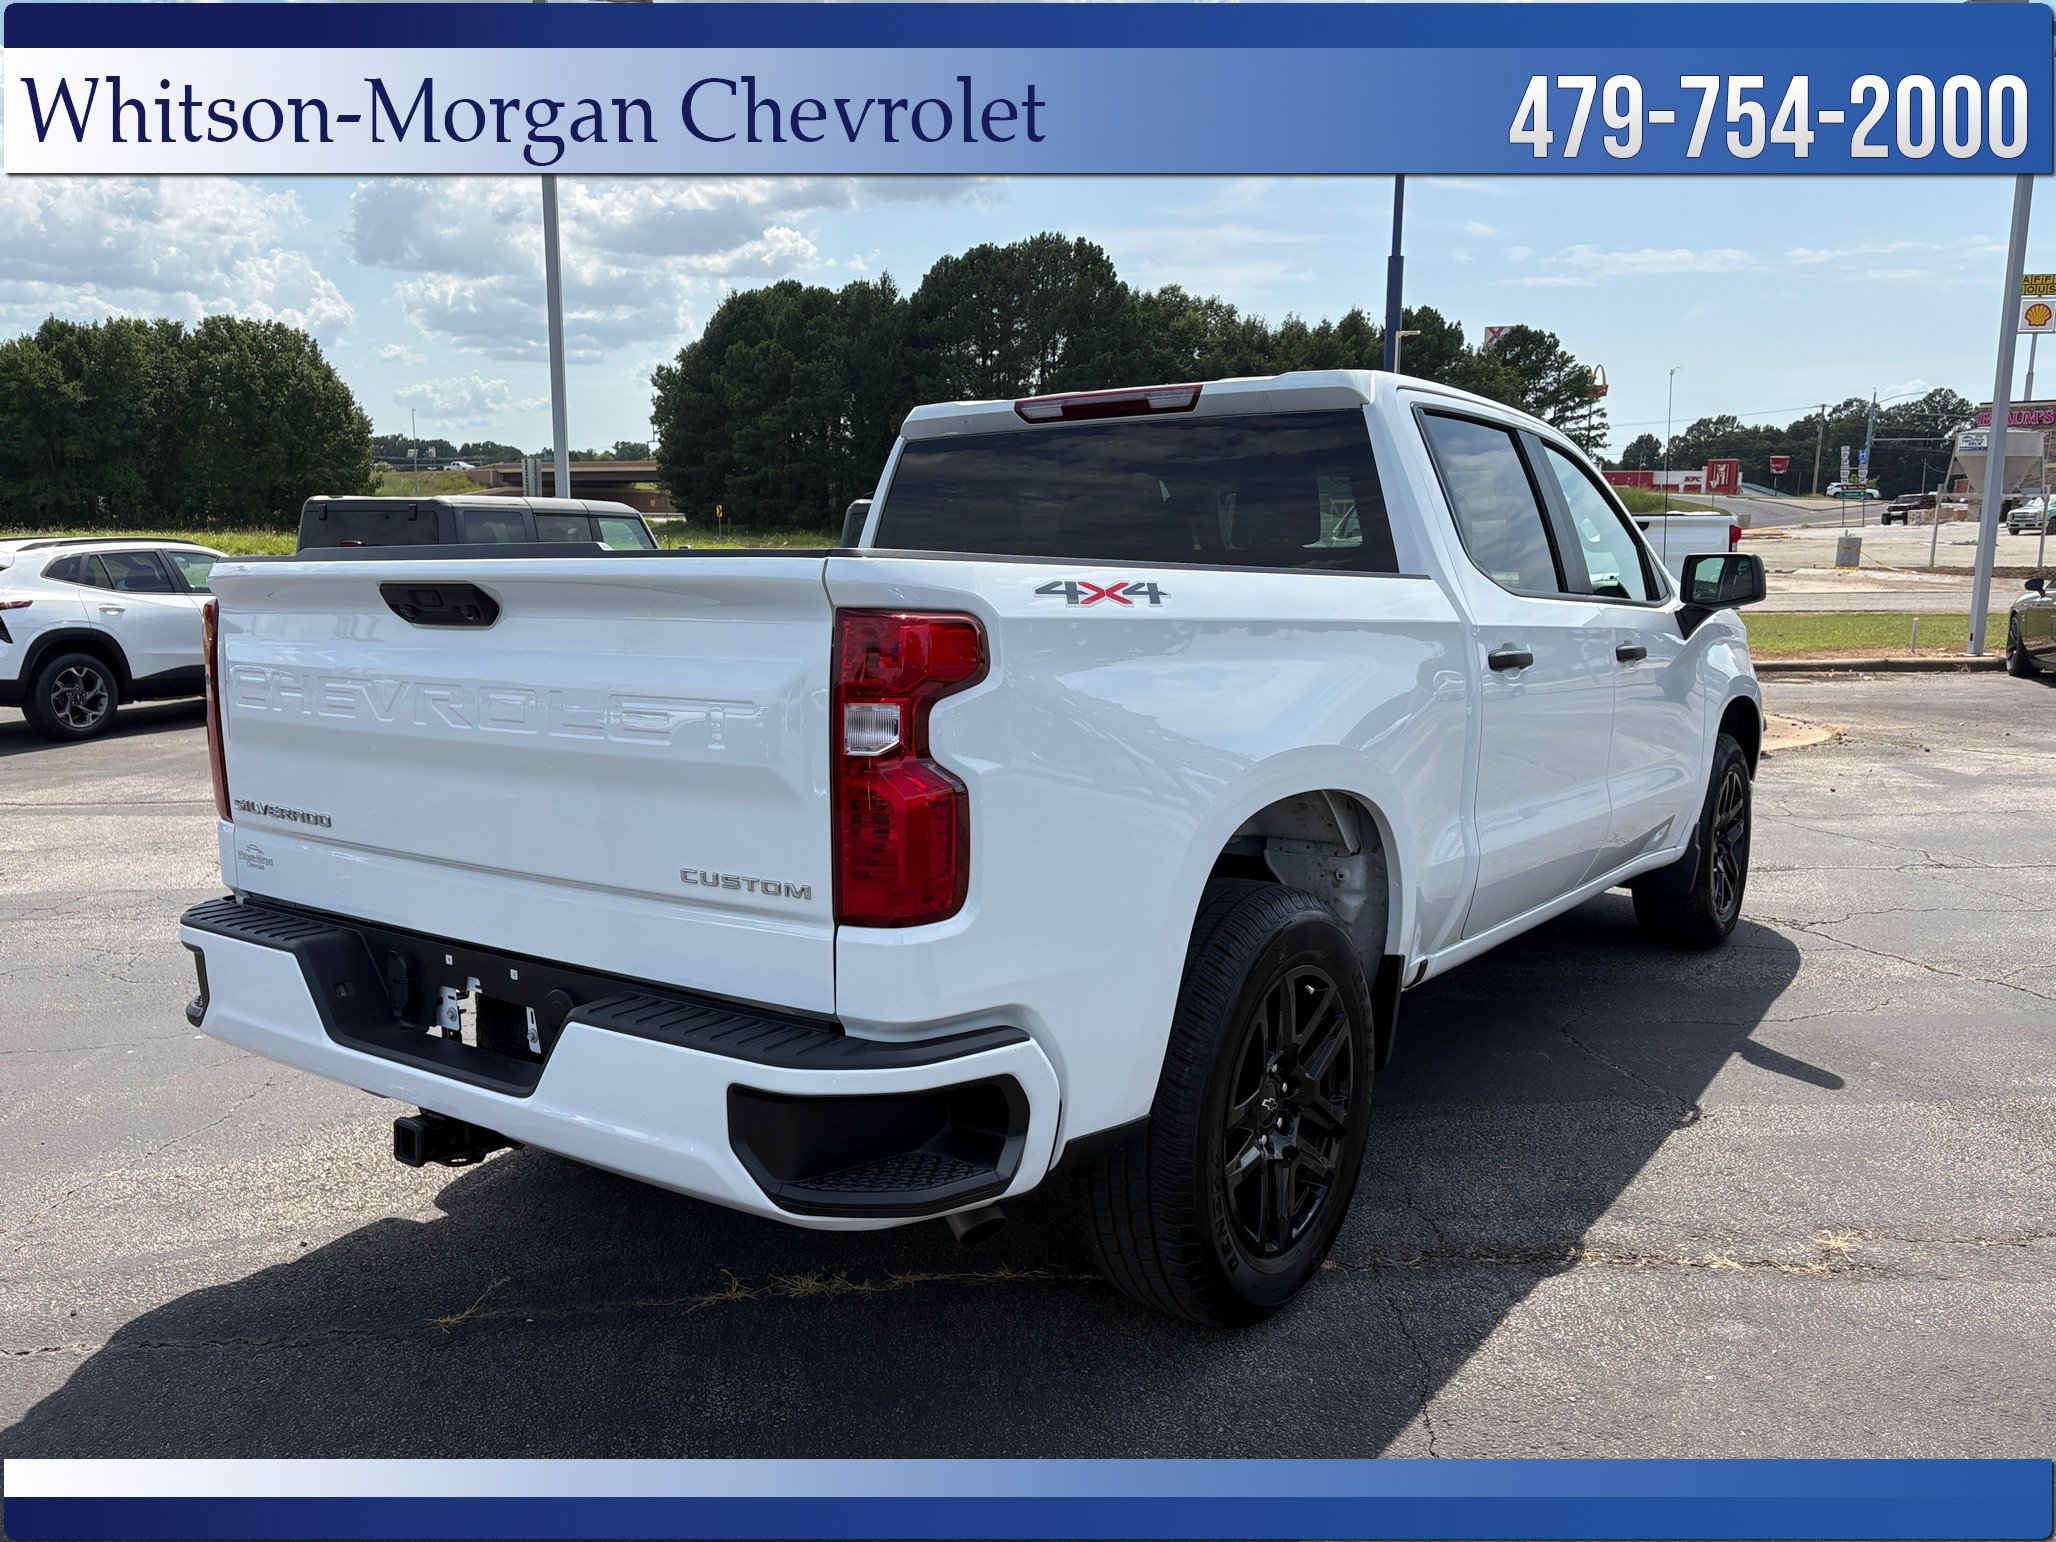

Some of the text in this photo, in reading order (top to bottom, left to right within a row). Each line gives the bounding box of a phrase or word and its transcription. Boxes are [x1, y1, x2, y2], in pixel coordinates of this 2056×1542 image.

[229, 664, 768, 750] CHEVROLET
[234, 797, 332, 828] SILVERADO
[680, 867, 812, 901] CUSTOM
